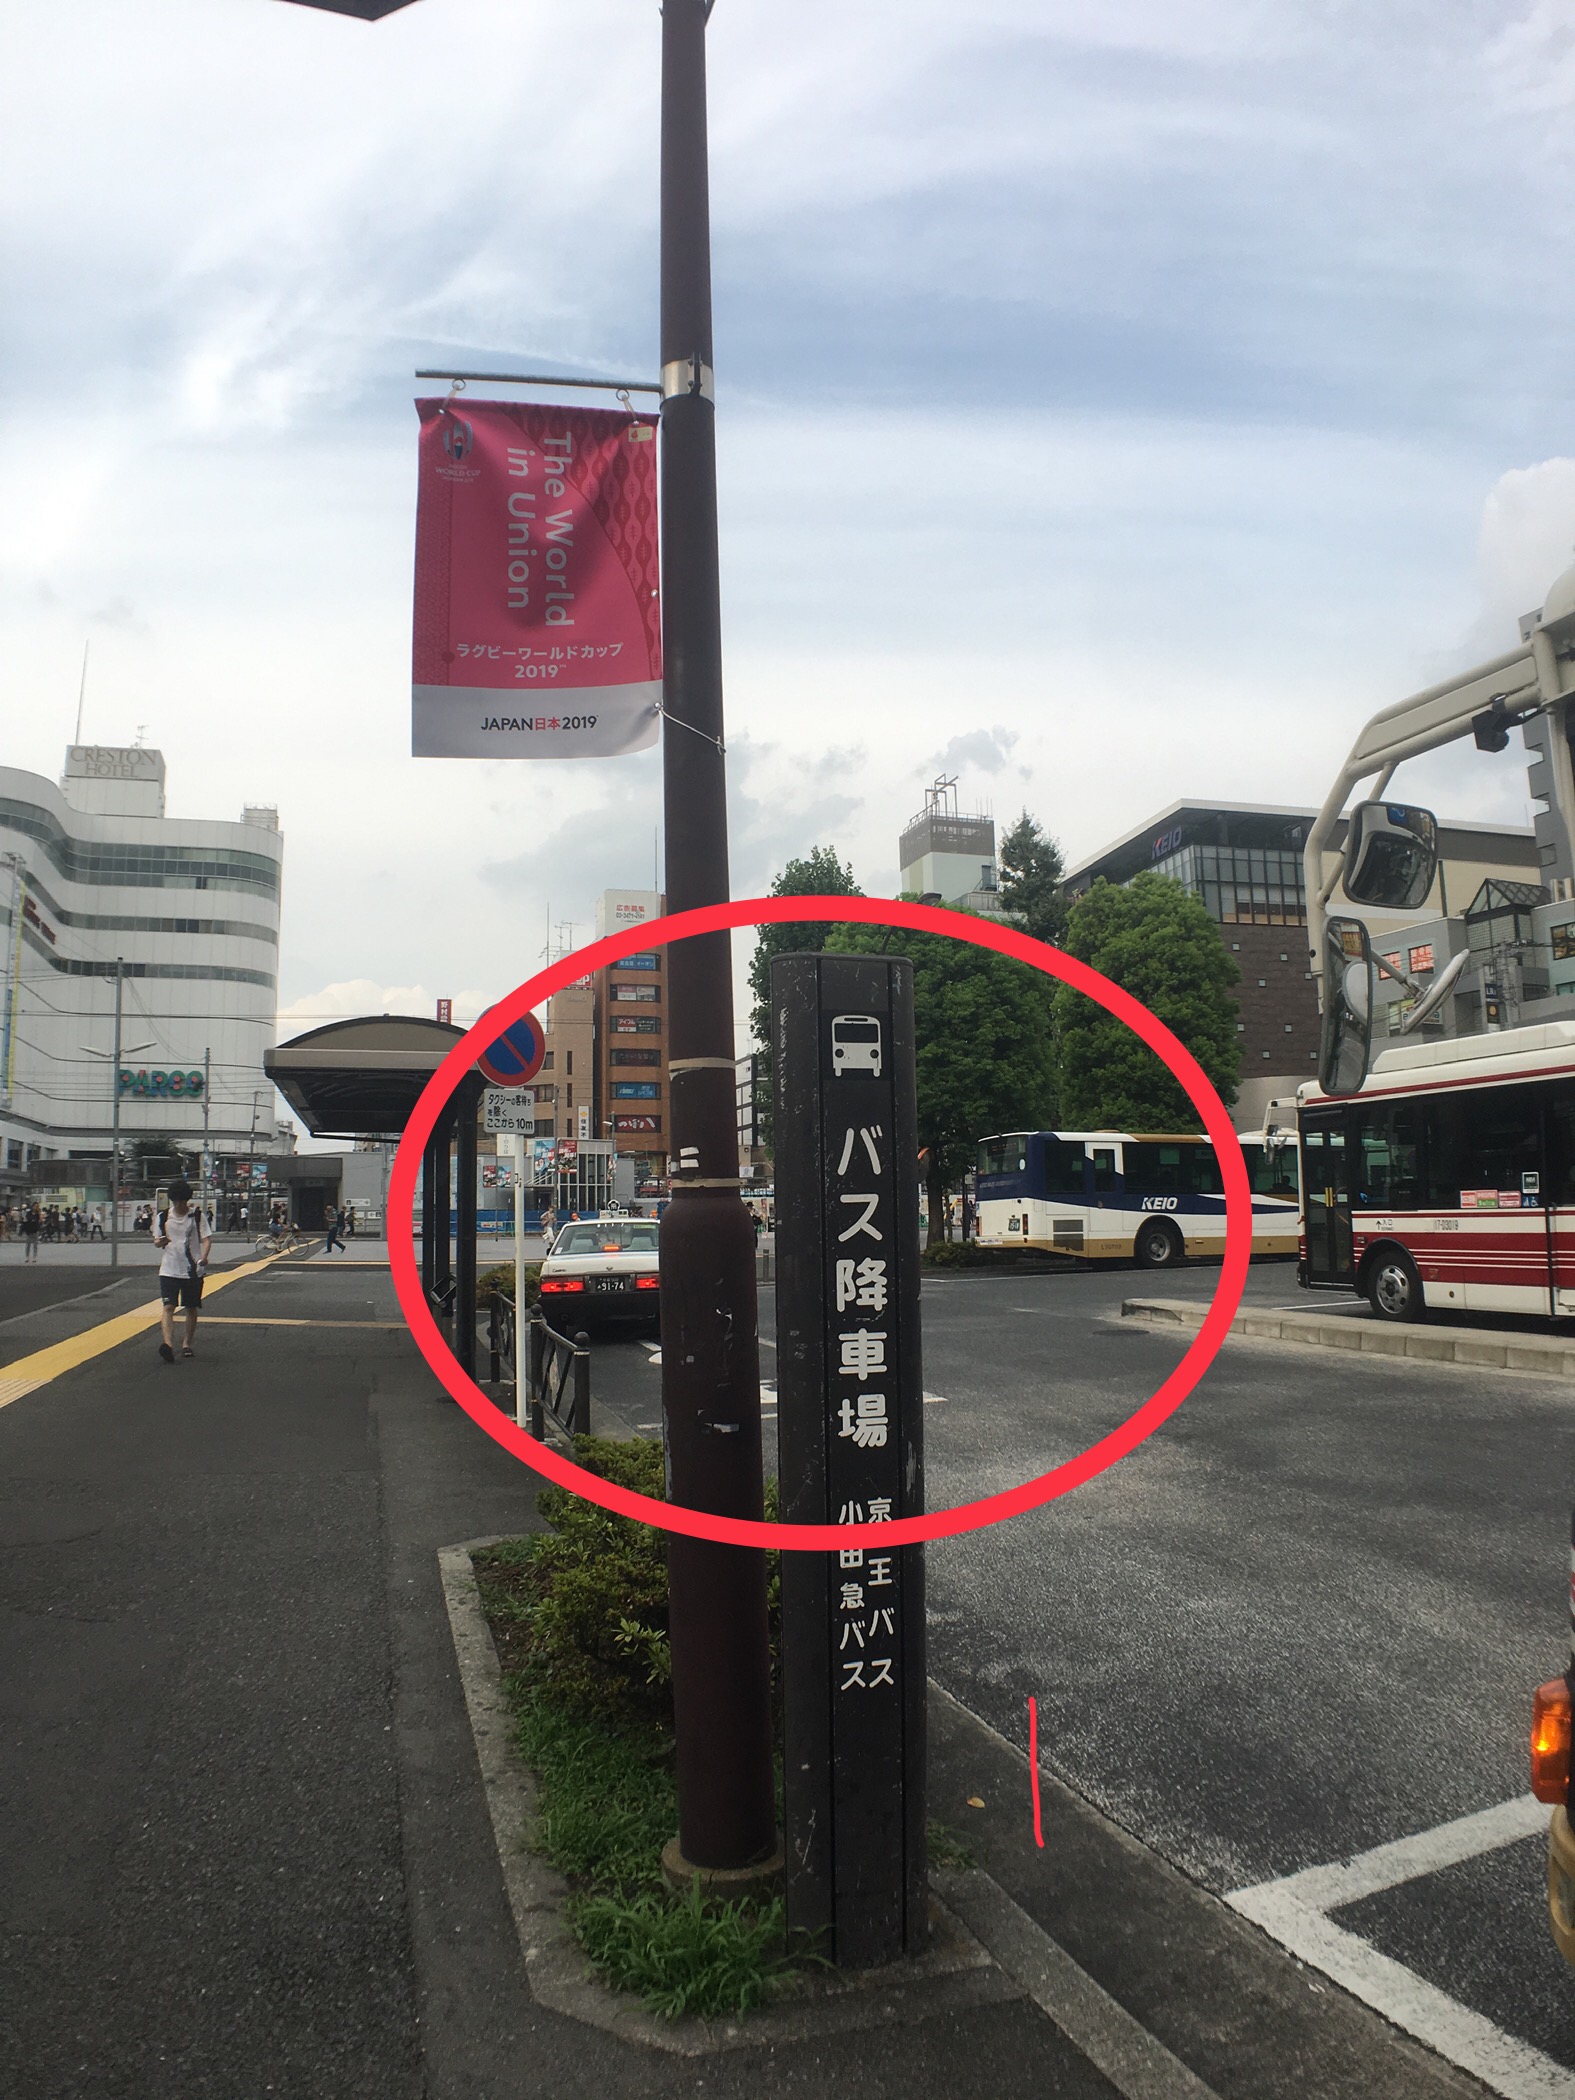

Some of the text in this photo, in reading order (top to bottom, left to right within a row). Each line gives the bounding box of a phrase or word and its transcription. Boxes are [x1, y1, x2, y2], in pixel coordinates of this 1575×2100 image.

[507, 447, 538, 608] in Union
[544, 431, 575, 626] The World
[456, 642, 624, 661] ラグビーワールドカップ
[70, 746, 156, 766] CRESTON
[85, 762, 139, 778] HOTEL
[1151, 826, 1183, 860] KEIO
[119, 1069, 204, 1098] PARCO
[487, 1105, 507, 1117] を除く
[488, 1094, 532, 1107] タクシーの客待ち
[1141, 1196, 1178, 1210] KEIO
[837, 1124, 889, 1449] バス降車場
[839, 1500, 867, 1690] 小田急バス
[867, 1497, 895, 1688] 京王バス
